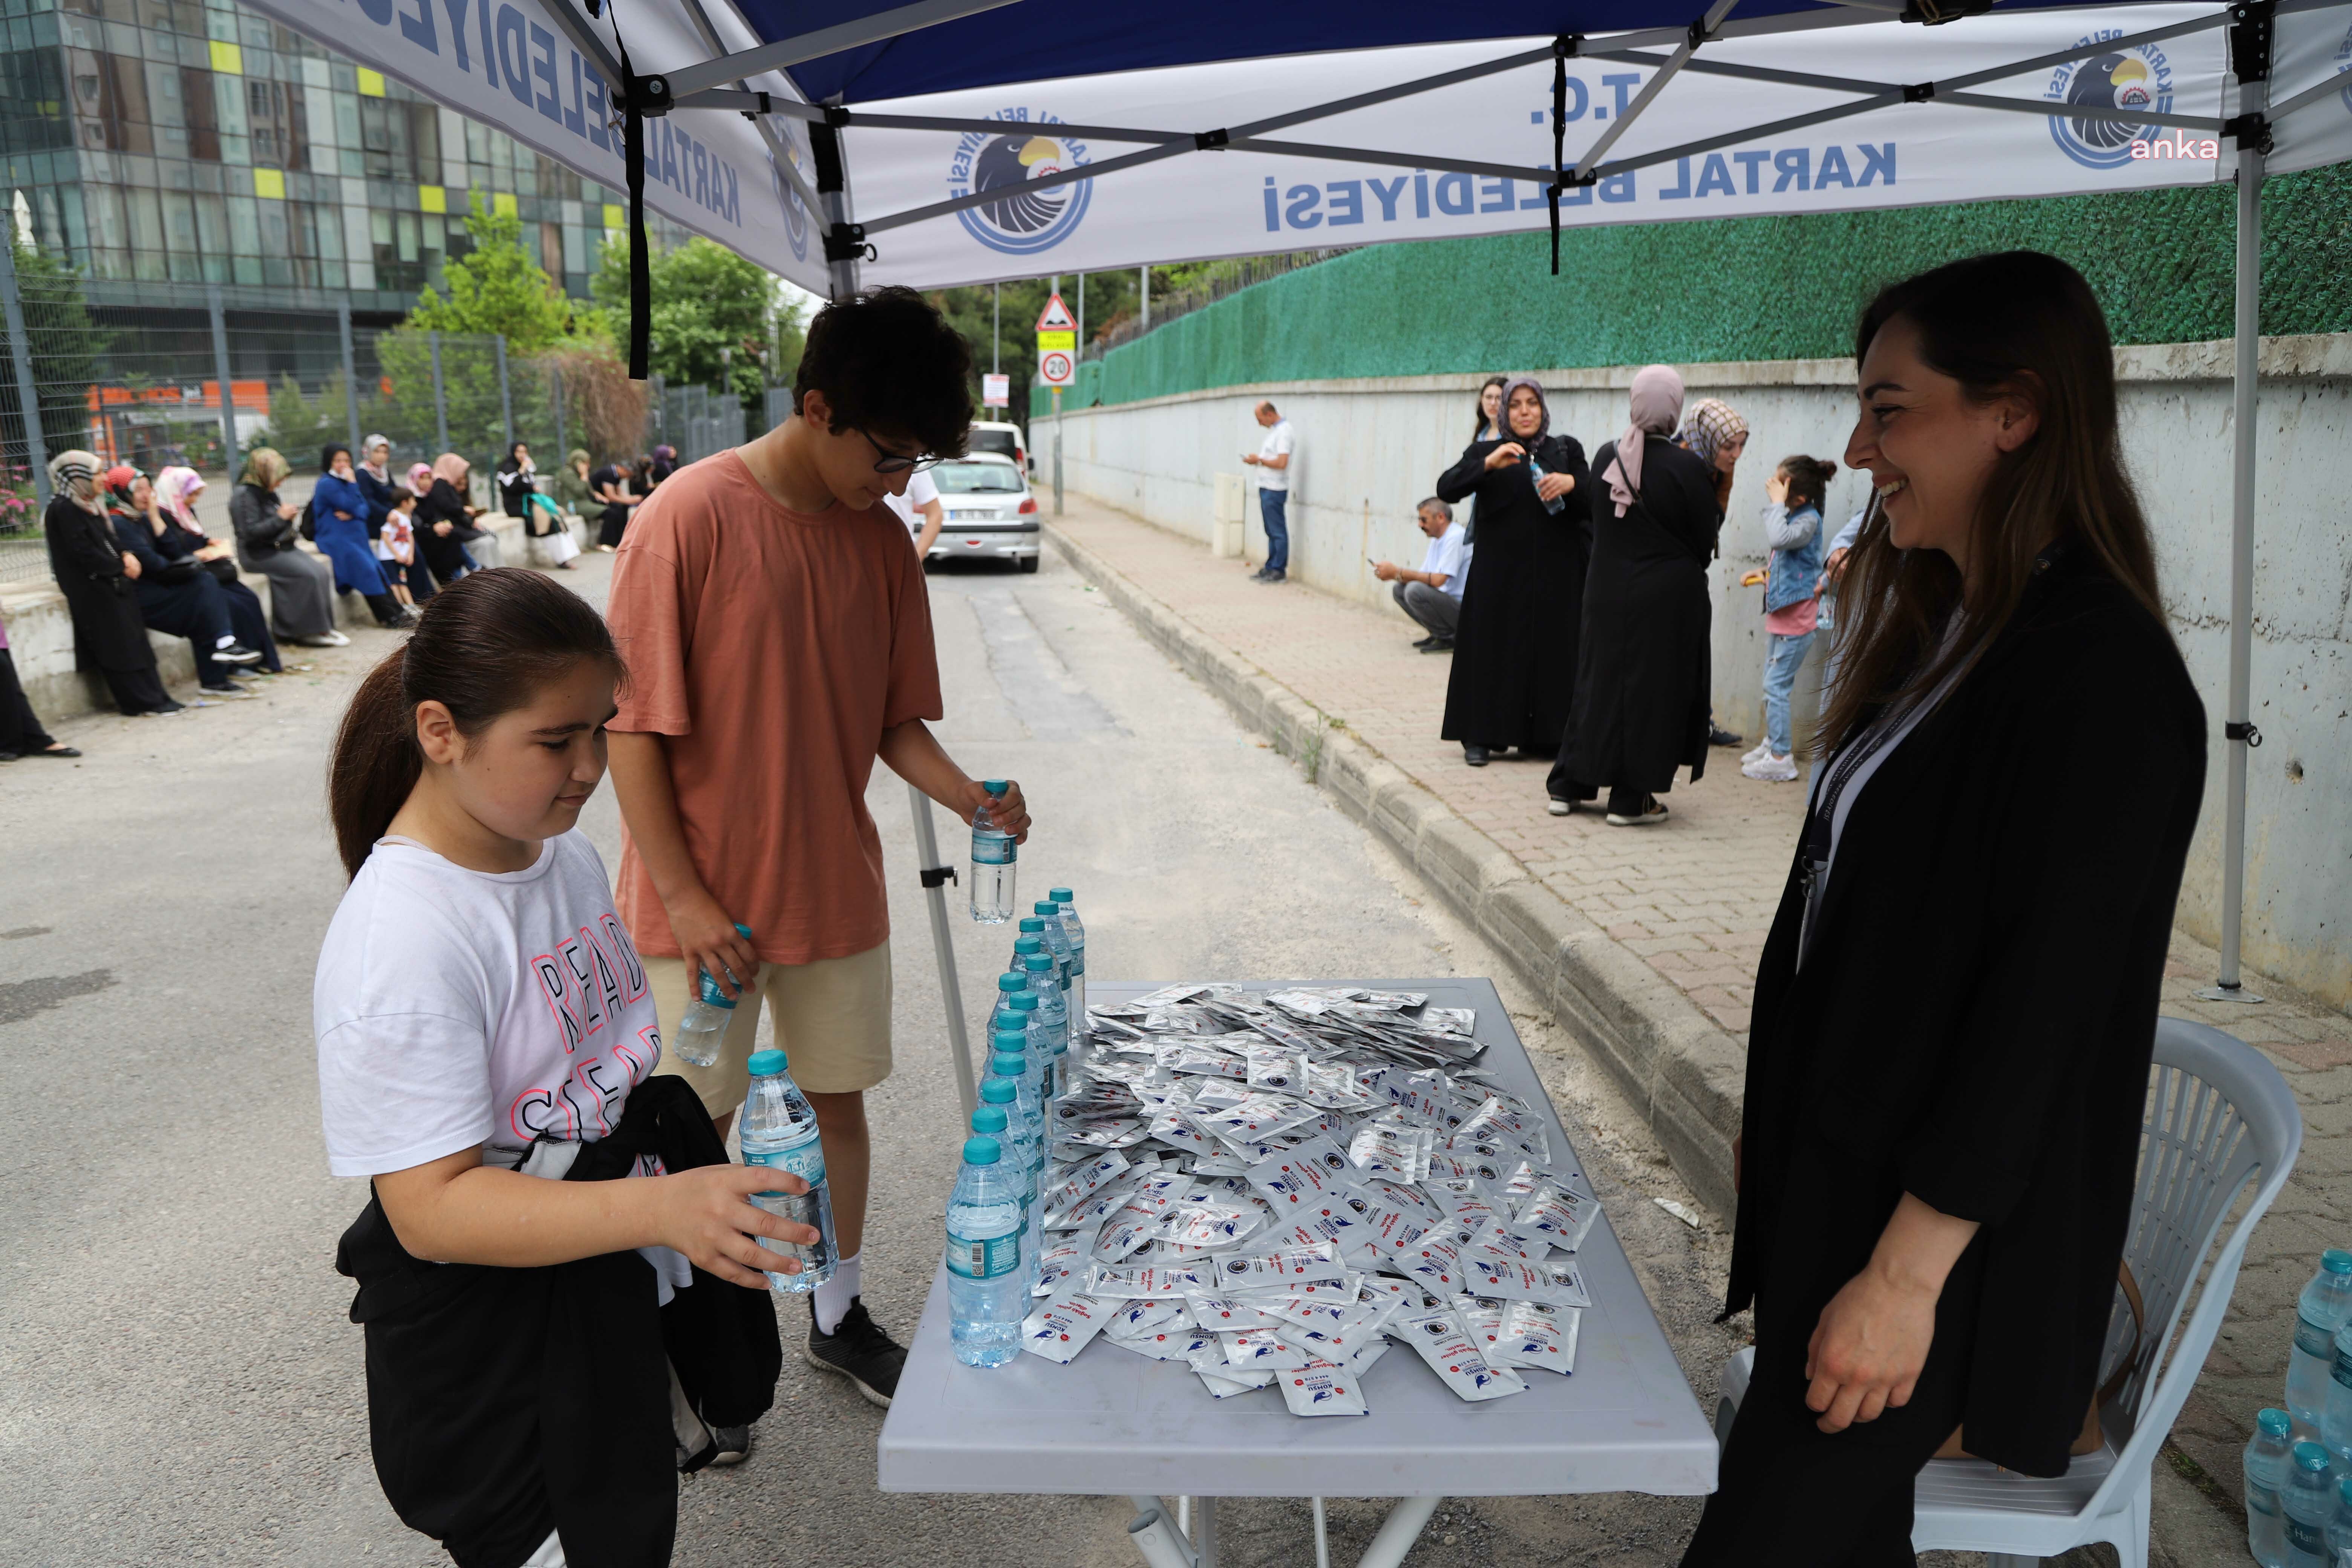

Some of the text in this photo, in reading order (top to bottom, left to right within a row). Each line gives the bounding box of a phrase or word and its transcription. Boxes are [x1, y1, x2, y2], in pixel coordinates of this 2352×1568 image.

[1049, 360, 1066, 375] 20
[531, 914, 648, 1054] READ
[1294, 1161, 1322, 1190] Sağlıklı günler
[1306, 1165, 1321, 1180] dilerim.
[1280, 1174, 1297, 1193] KOMŞU
[1323, 1218, 1340, 1234] KOMŞU
[1381, 1223, 1392, 1239] günler
[1068, 1301, 1087, 1311] dilerim.
[1122, 1302, 1143, 1316] KOMŞU
[1288, 1300, 1300, 1311] ünler
[1071, 1307, 1091, 1319] Sağlıklı
[1044, 1322, 1066, 1332] KOMŞU
[1524, 1337, 1548, 1345] KOMŞU
[1441, 1350, 1458, 1360] günler
[1465, 1366, 1488, 1376] KOMŞU
